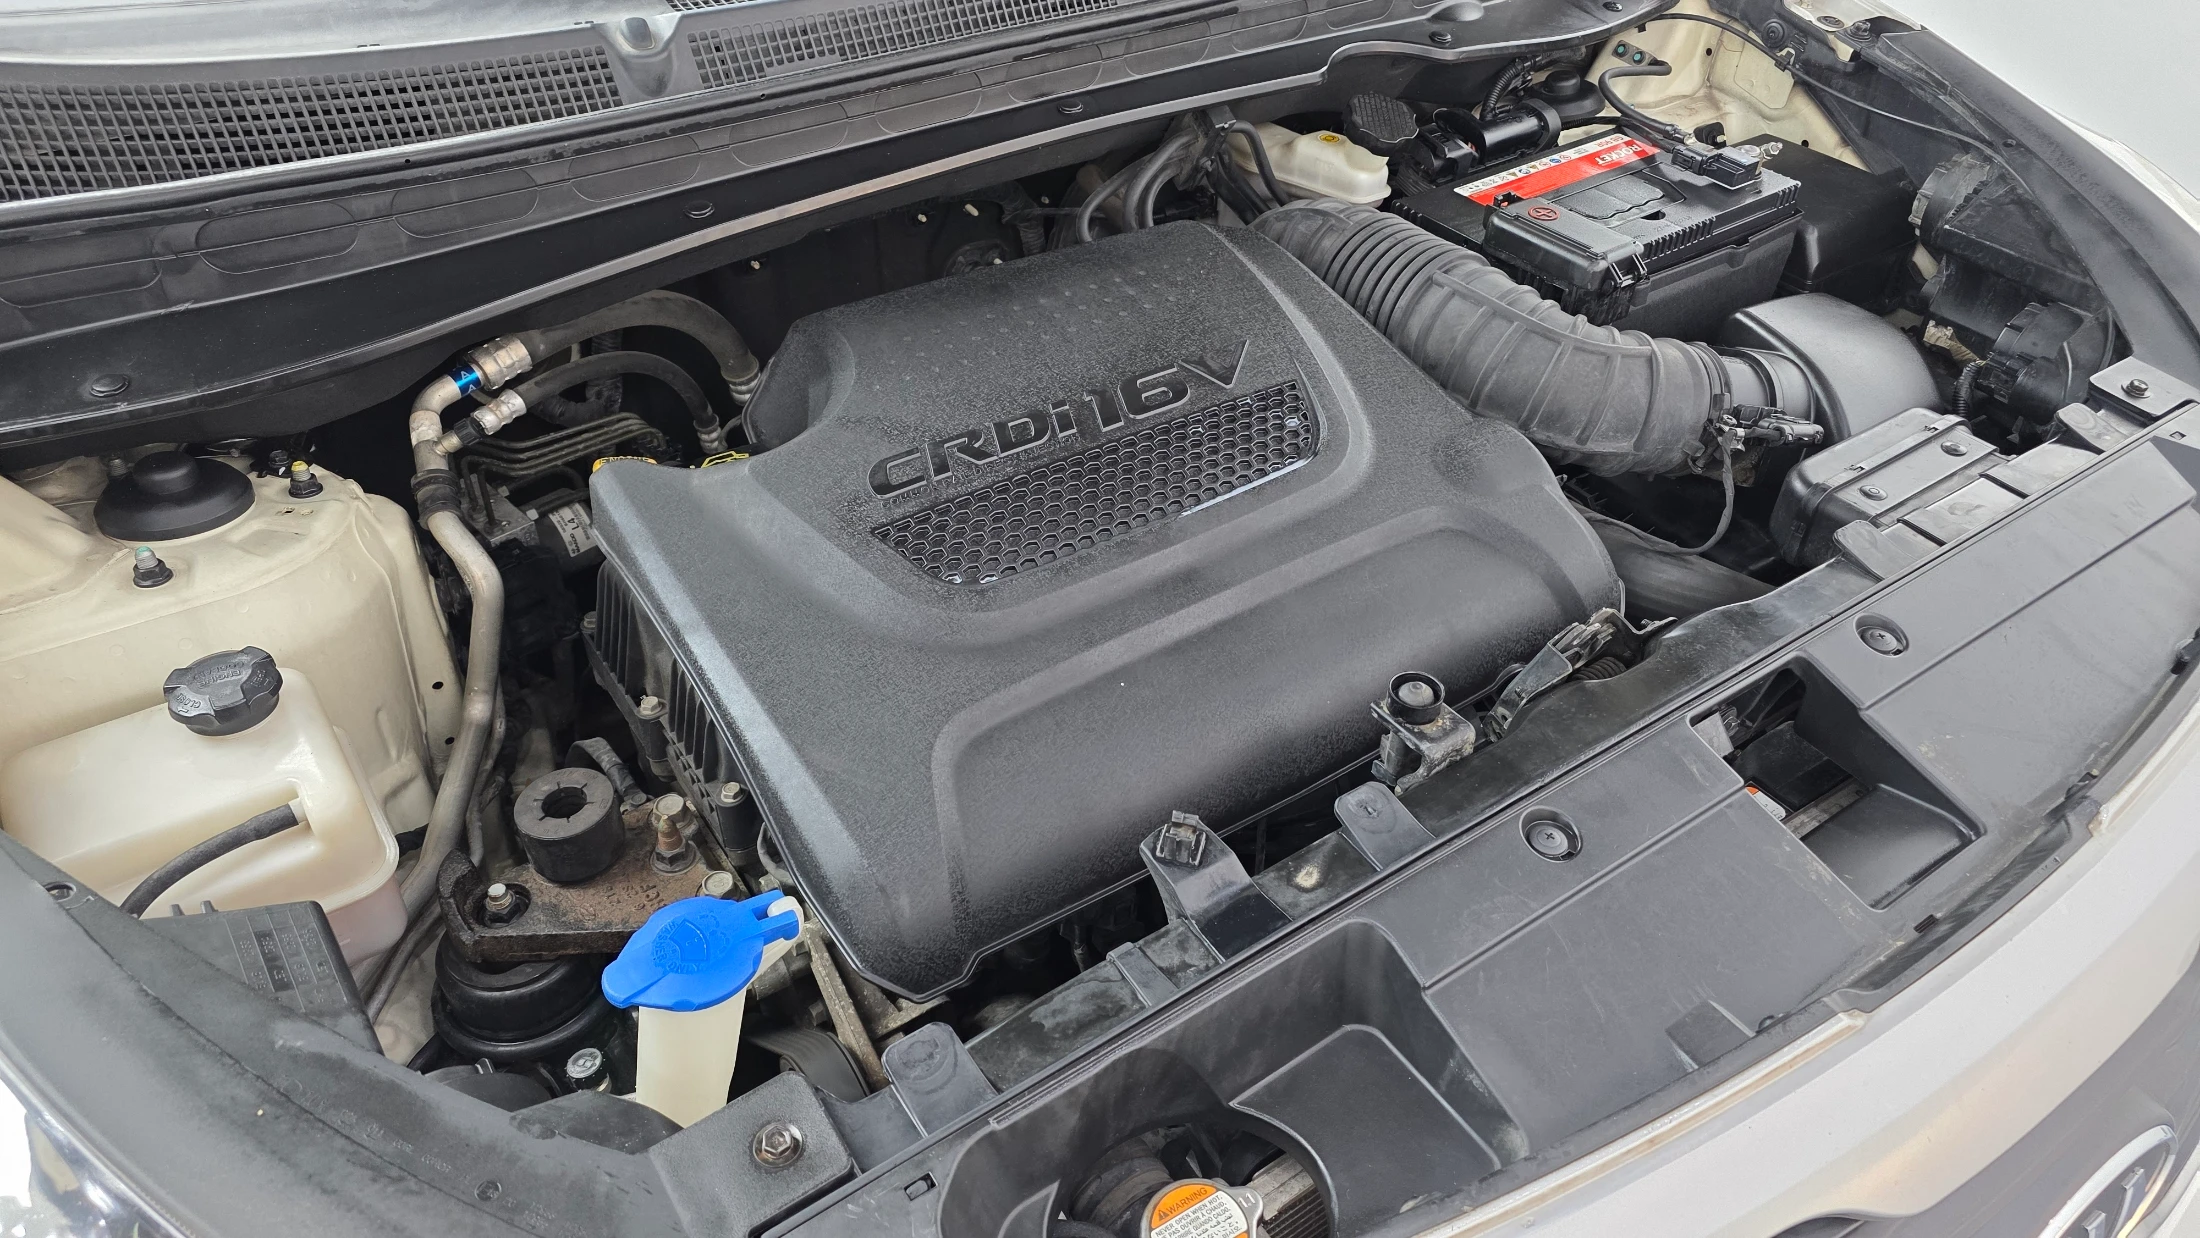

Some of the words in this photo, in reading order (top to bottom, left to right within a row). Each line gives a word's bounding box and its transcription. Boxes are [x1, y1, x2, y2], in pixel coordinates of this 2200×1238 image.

[1594, 144, 1642, 165] ROCKET
[1166, 1187, 1208, 1215] WARNING
[1155, 1222, 1175, 1237] NEVER
[1175, 1213, 1191, 1225] OPEN
[1191, 1203, 1208, 1216] WHEN
[1208, 1194, 1223, 1206] HOT.
[1168, 1227, 1181, 1238] PAS
[1181, 1216, 1201, 1231] OUVRIR
[1205, 1201, 1227, 1215] CHAUD.
[1192, 1216, 1213, 1231] QUANDO
